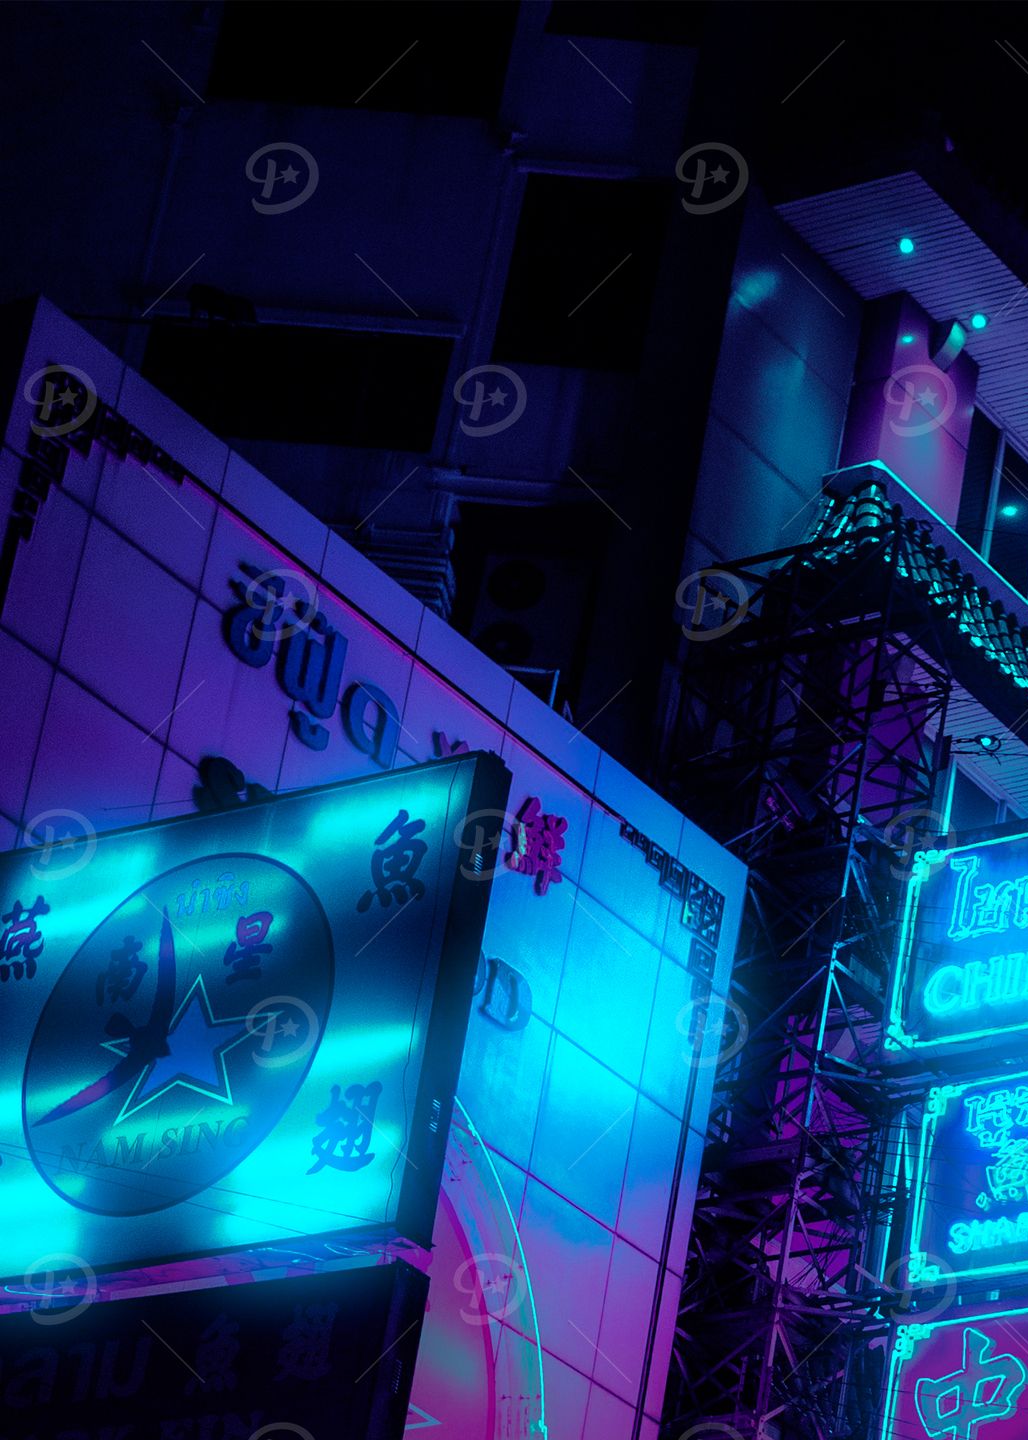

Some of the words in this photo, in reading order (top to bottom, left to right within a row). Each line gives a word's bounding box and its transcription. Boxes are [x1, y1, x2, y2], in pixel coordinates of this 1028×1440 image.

[0, 895, 50, 980] 燕
[60, 1132, 149, 1173] NAM
[159, 1115, 252, 1160] SING
